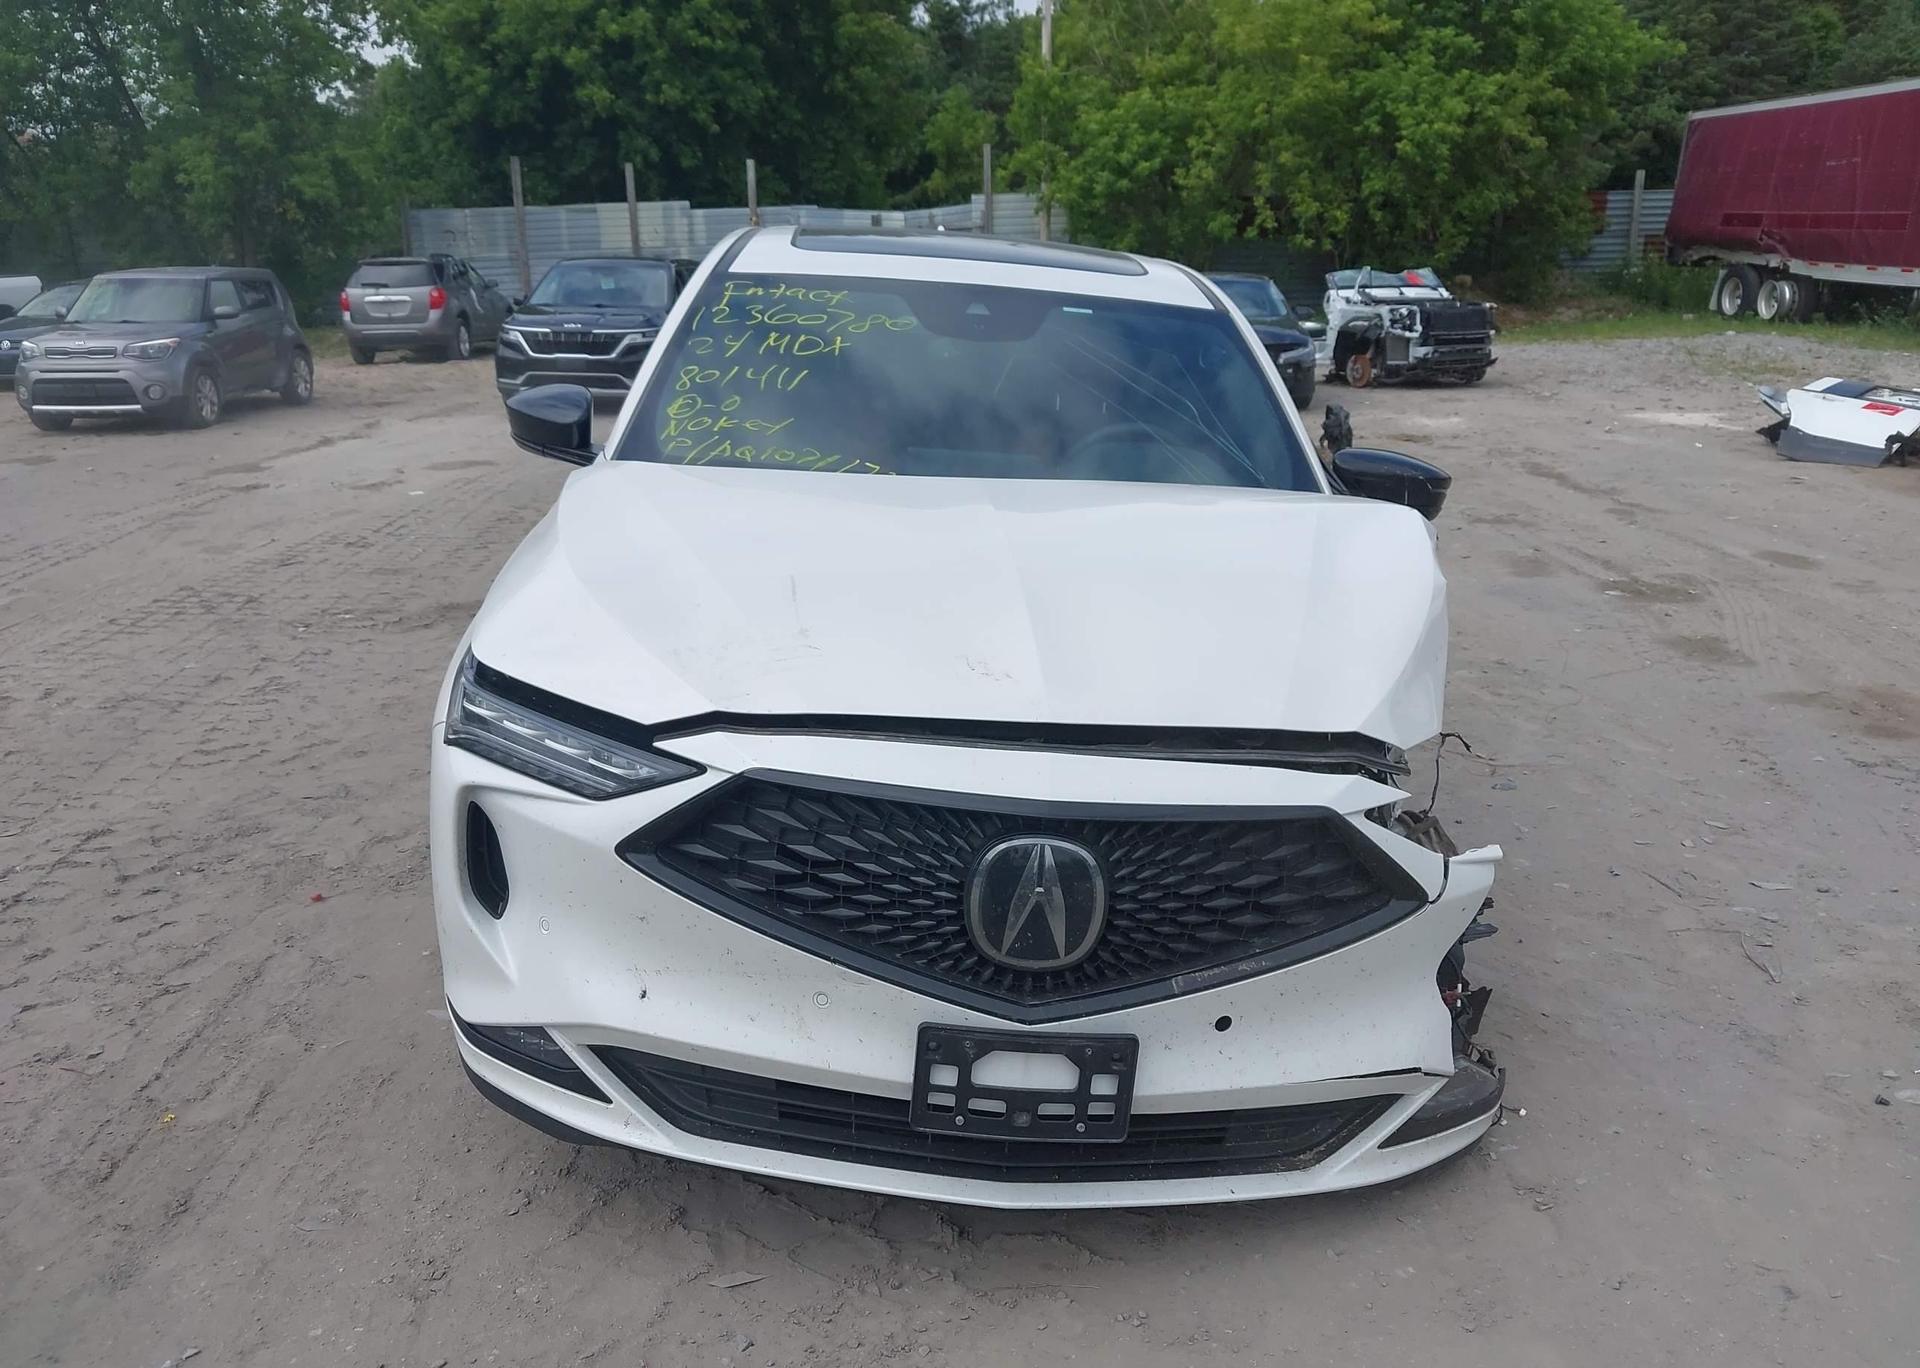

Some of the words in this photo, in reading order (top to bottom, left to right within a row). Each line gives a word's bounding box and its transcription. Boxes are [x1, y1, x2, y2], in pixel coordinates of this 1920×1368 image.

[693, 304, 917, 333] 12360780
[689, 331, 753, 357] 24
[676, 365, 808, 391] 801411
